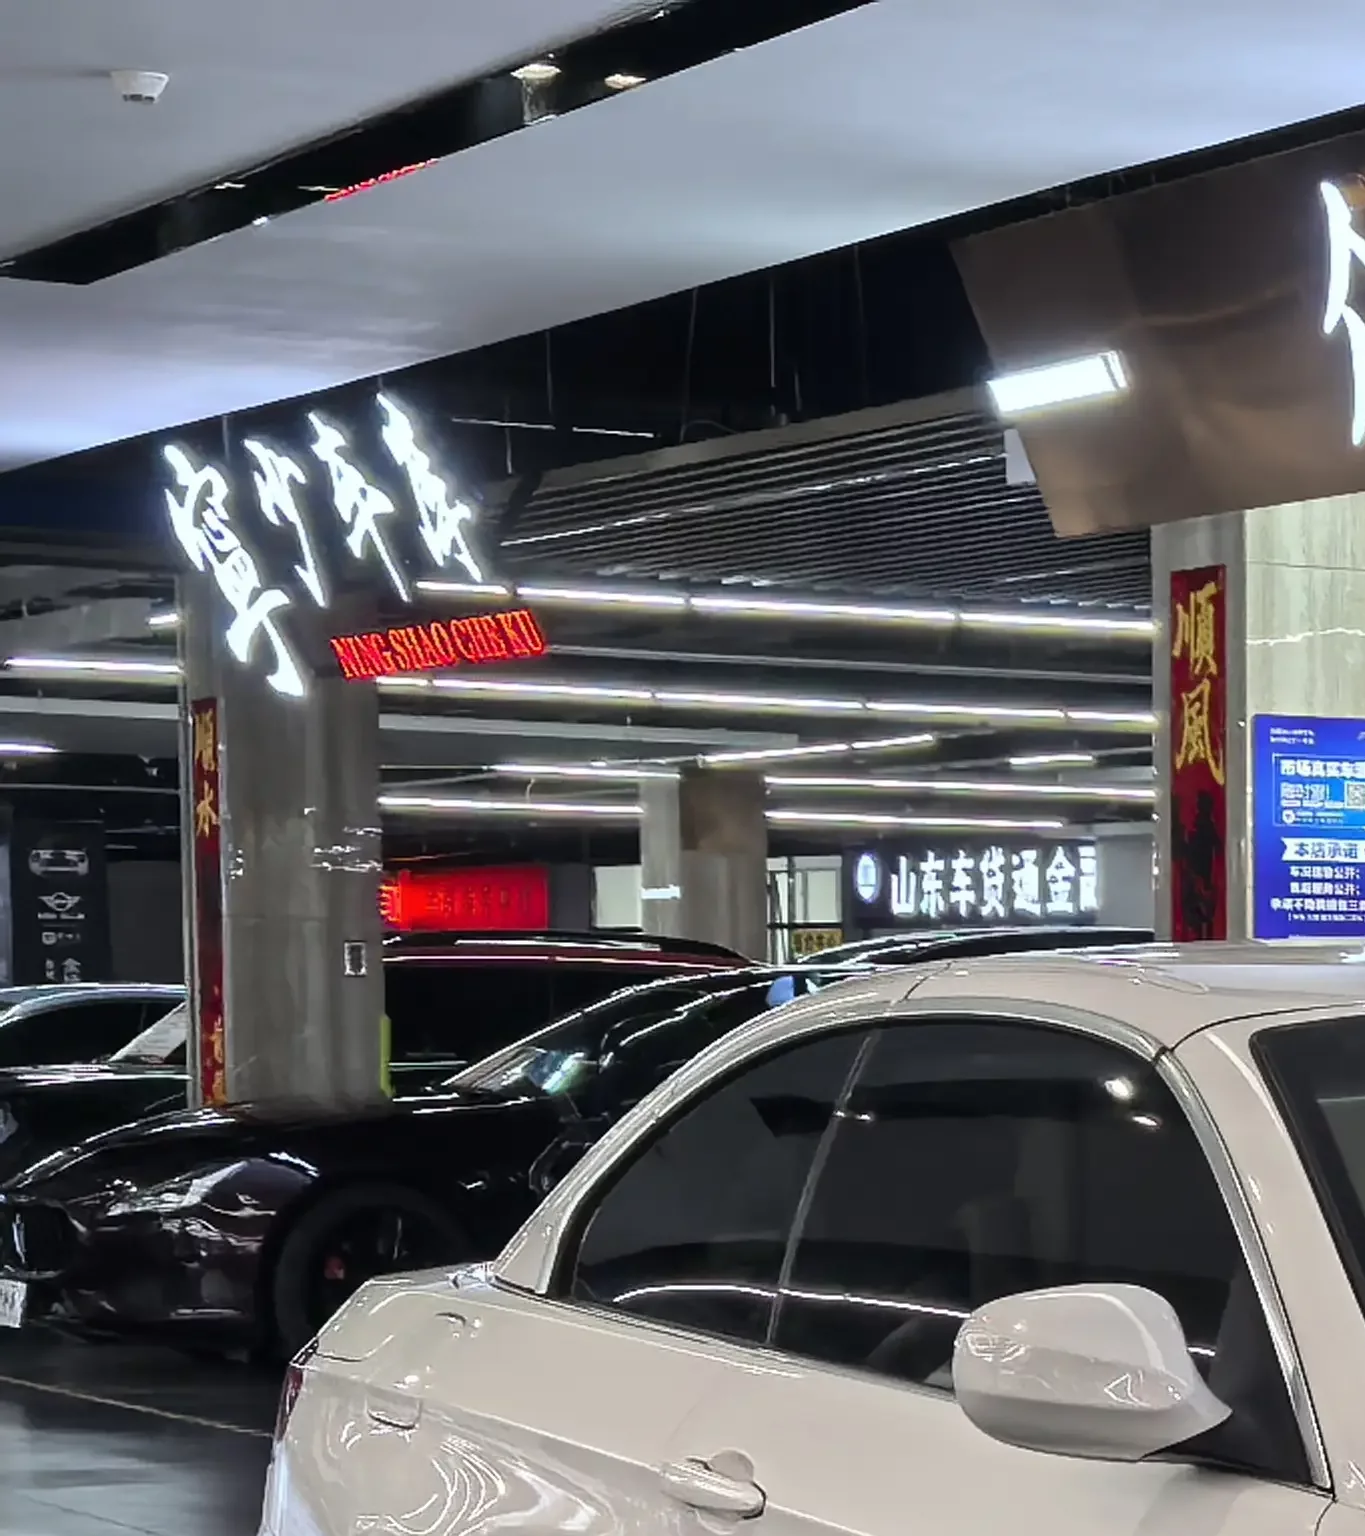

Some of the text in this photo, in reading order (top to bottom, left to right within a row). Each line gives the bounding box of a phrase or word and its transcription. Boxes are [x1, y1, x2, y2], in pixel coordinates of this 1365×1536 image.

[330, 609, 545, 678] NING SHAO CHE KU
